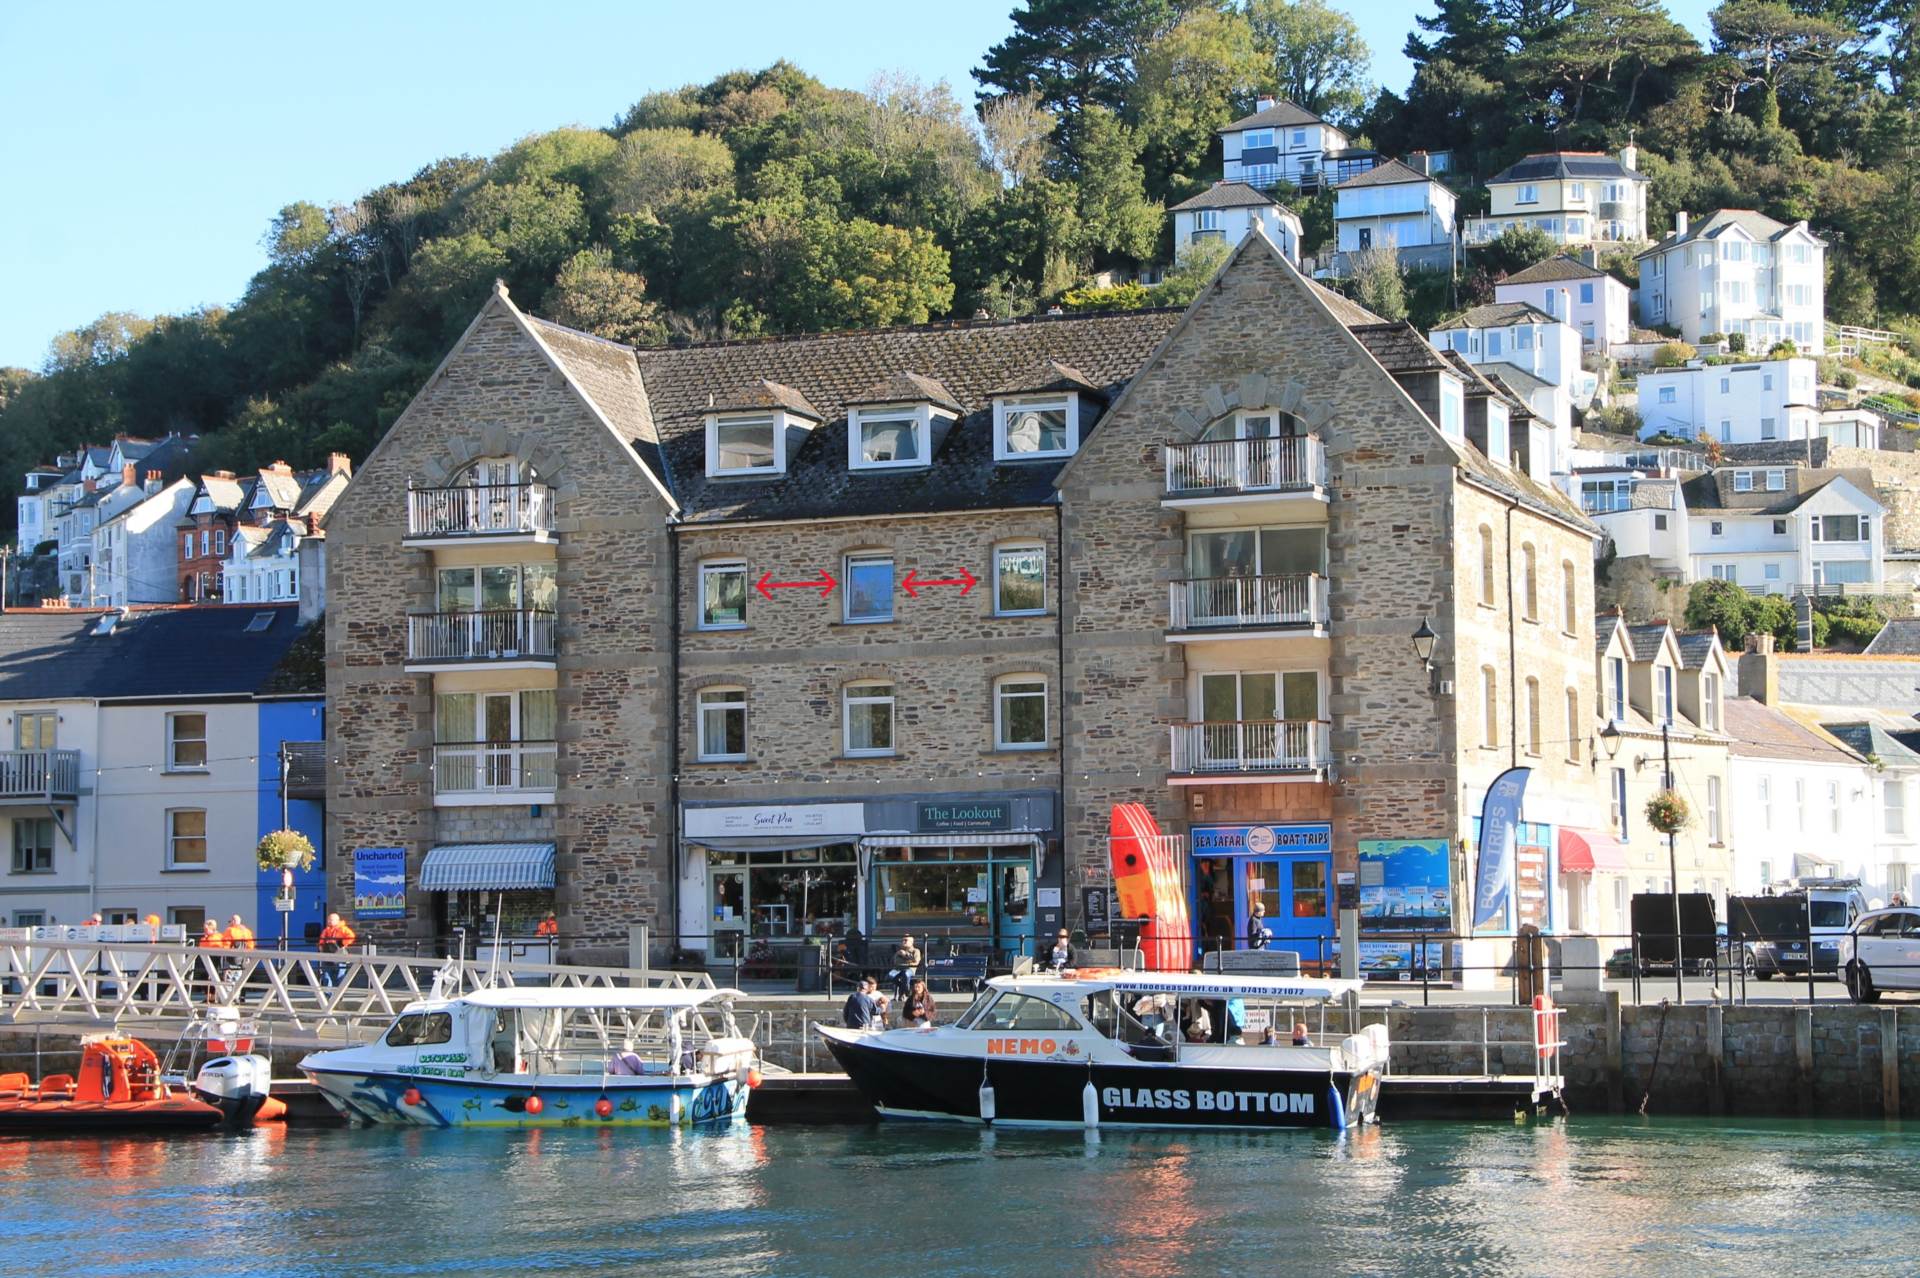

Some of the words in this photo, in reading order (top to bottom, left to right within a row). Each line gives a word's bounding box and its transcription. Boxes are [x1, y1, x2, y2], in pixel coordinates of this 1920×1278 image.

[754, 812, 775, 826] Sweet
[777, 811, 793, 824] Pea
[924, 807, 949, 820] The
[952, 806, 1002, 820] Lookout
[1488, 806, 1506, 856] TRIPS
[1195, 835, 1211, 848] SEA
[1213, 834, 1245, 847] SAFARI
[1277, 834, 1300, 846] BOAT
[1303, 832, 1328, 845] TRIPS
[356, 851, 403, 861] Uncharted
[1480, 862, 1499, 909] BOAT
[1115, 983, 1234, 993] www.looeseasafari.co.uk
[1241, 986, 1268, 994] 07415
[1271, 987, 1305, 996] 321072
[987, 1038, 1057, 1055] NEMO
[1102, 1087, 1191, 1110] GLASS
[1197, 1091, 1315, 1114] BOTTOM
